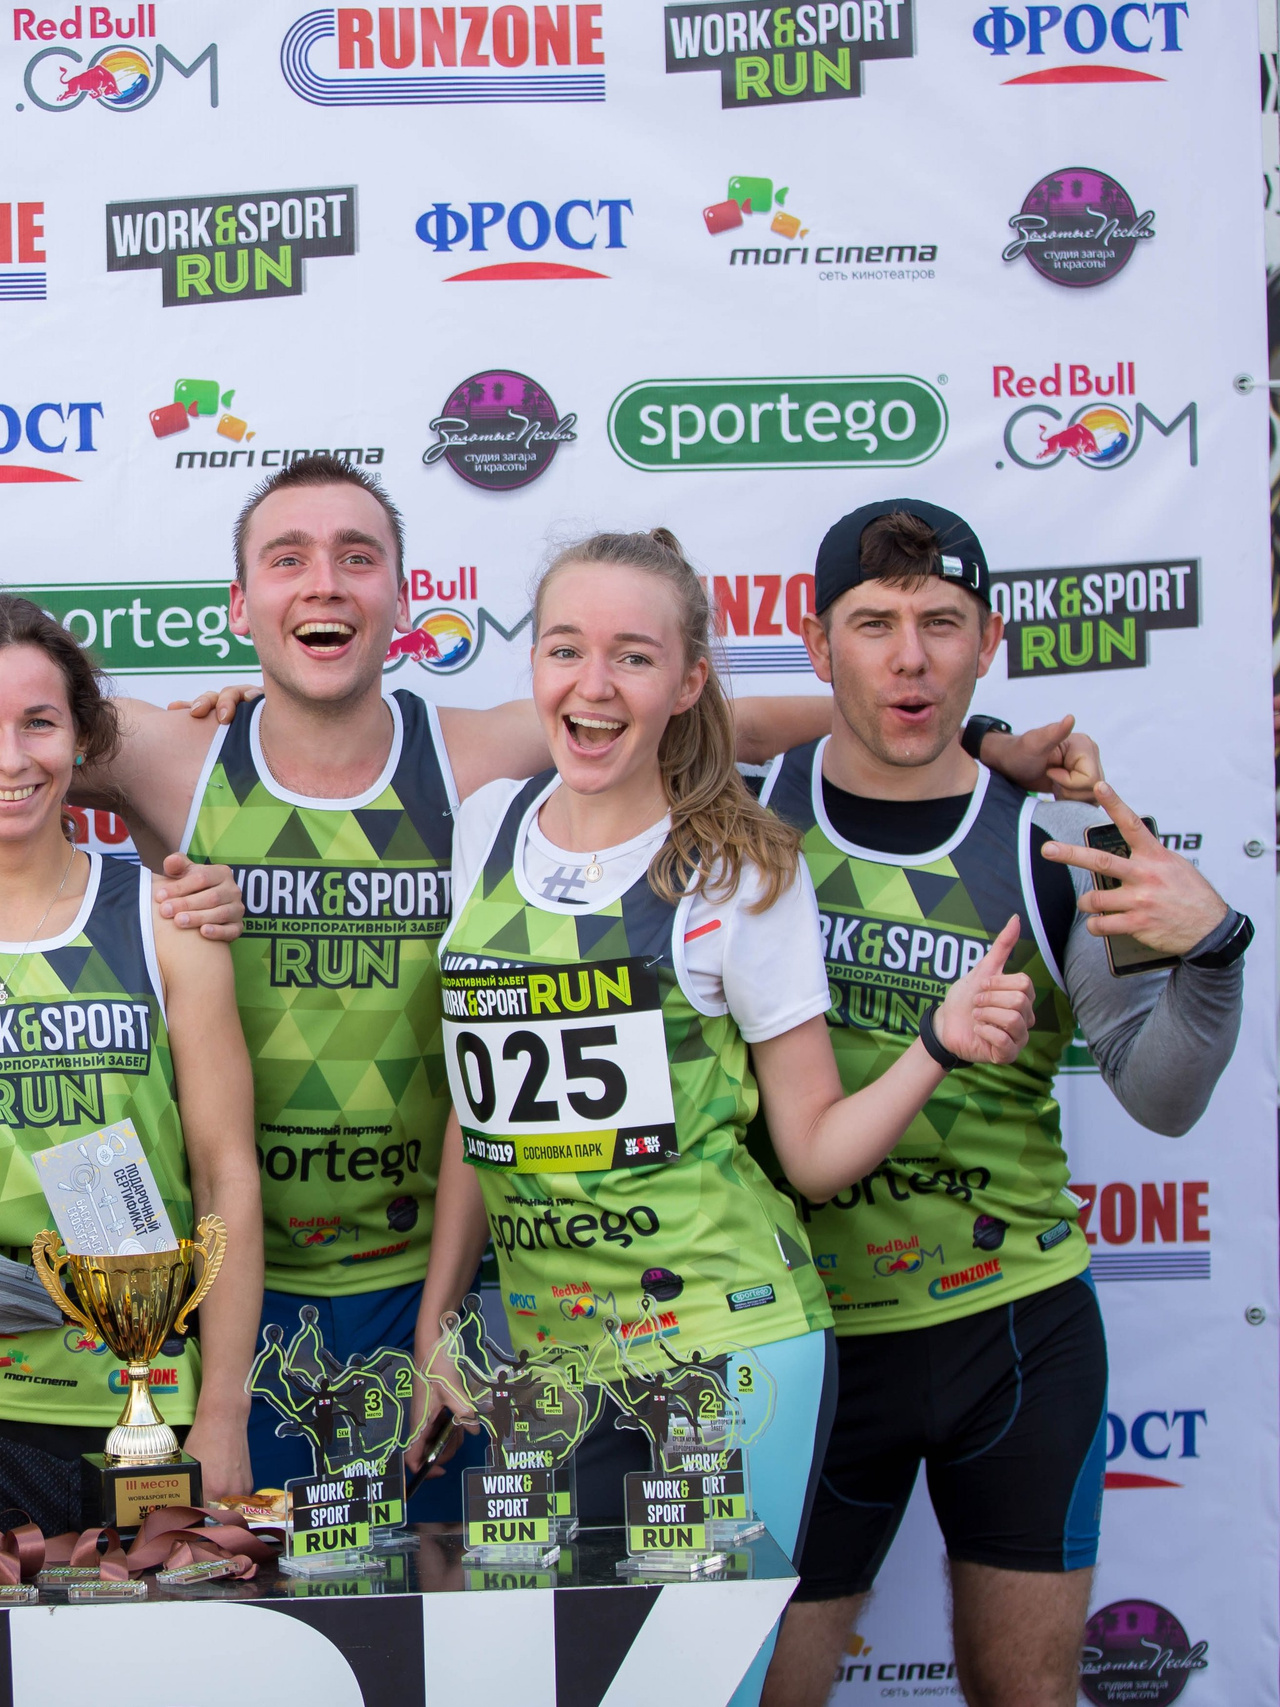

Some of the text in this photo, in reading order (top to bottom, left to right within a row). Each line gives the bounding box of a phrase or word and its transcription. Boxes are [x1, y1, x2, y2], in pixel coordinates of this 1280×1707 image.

[14, 3, 156, 41] Red Bull
[669, 0, 904, 60] WORK&SPORT
[972, 1, 1189, 56] ФРОСТ
[338, 3, 605, 69] RUNZONE
[734, 47, 852, 100] RUN
[111, 194, 348, 258] WORK&SPORT
[415, 199, 633, 253] ФРОСТ
[729, 243, 938, 267] mori cinema
[1043, 248, 1116, 262] студия загара
[1062, 257, 1106, 270] красоты
[176, 245, 293, 299] RUN
[819, 267, 936, 283] сеть кинотеатров
[993, 361, 1135, 398] Red Bull
[637, 392, 917, 459] sportego
[176, 449, 255, 470] mori
[464, 451, 537, 466] студия загара
[482, 460, 528, 474] красоты
[411, 566, 477, 602] Bull
[992, 565, 1191, 626] ORK&SPORT
[1021, 617, 1136, 671] RUN
[282, 920, 445, 933] КОРПОРАТИВНЫЙ ЗАБЕГ
[275, 938, 396, 984] RUN
[498, 975, 525, 986] ЗАБЕГ
[528, 966, 633, 1014] RUN
[108, 1055, 145, 1067] ЗАБЕГ
[456, 1025, 628, 1124] 025
[261, 1122, 392, 1137] генеральный партнер
[523, 1142, 603, 1160] СОСНОВКА ПАРК
[114, 1168, 148, 1236] СЕРТИФИКАТ
[125, 1163, 161, 1233] ПОДАРОЧНЫЙ
[289, 1216, 341, 1228] Red Bull
[1072, 1181, 1210, 1246] ZONE
[491, 1205, 660, 1262] sportego
[867, 1235, 919, 1256] Red Bull
[940, 1258, 1001, 1292] RUNZONE
[509, 1293, 537, 1310] ФРОСТ
[552, 1281, 592, 1298] Red Bull
[4, 1372, 78, 1388] mori cinema
[306, 1480, 354, 1504] WORK&
[483, 1473, 532, 1493] WORK&
[642, 1479, 689, 1499] WORK&
[311, 1504, 350, 1528] SPORT
[488, 1498, 528, 1518] SPORT
[647, 1504, 686, 1523] SPORT
[306, 1527, 357, 1553] RUN
[482, 1521, 535, 1542] RUN
[643, 1527, 692, 1547] RUN
